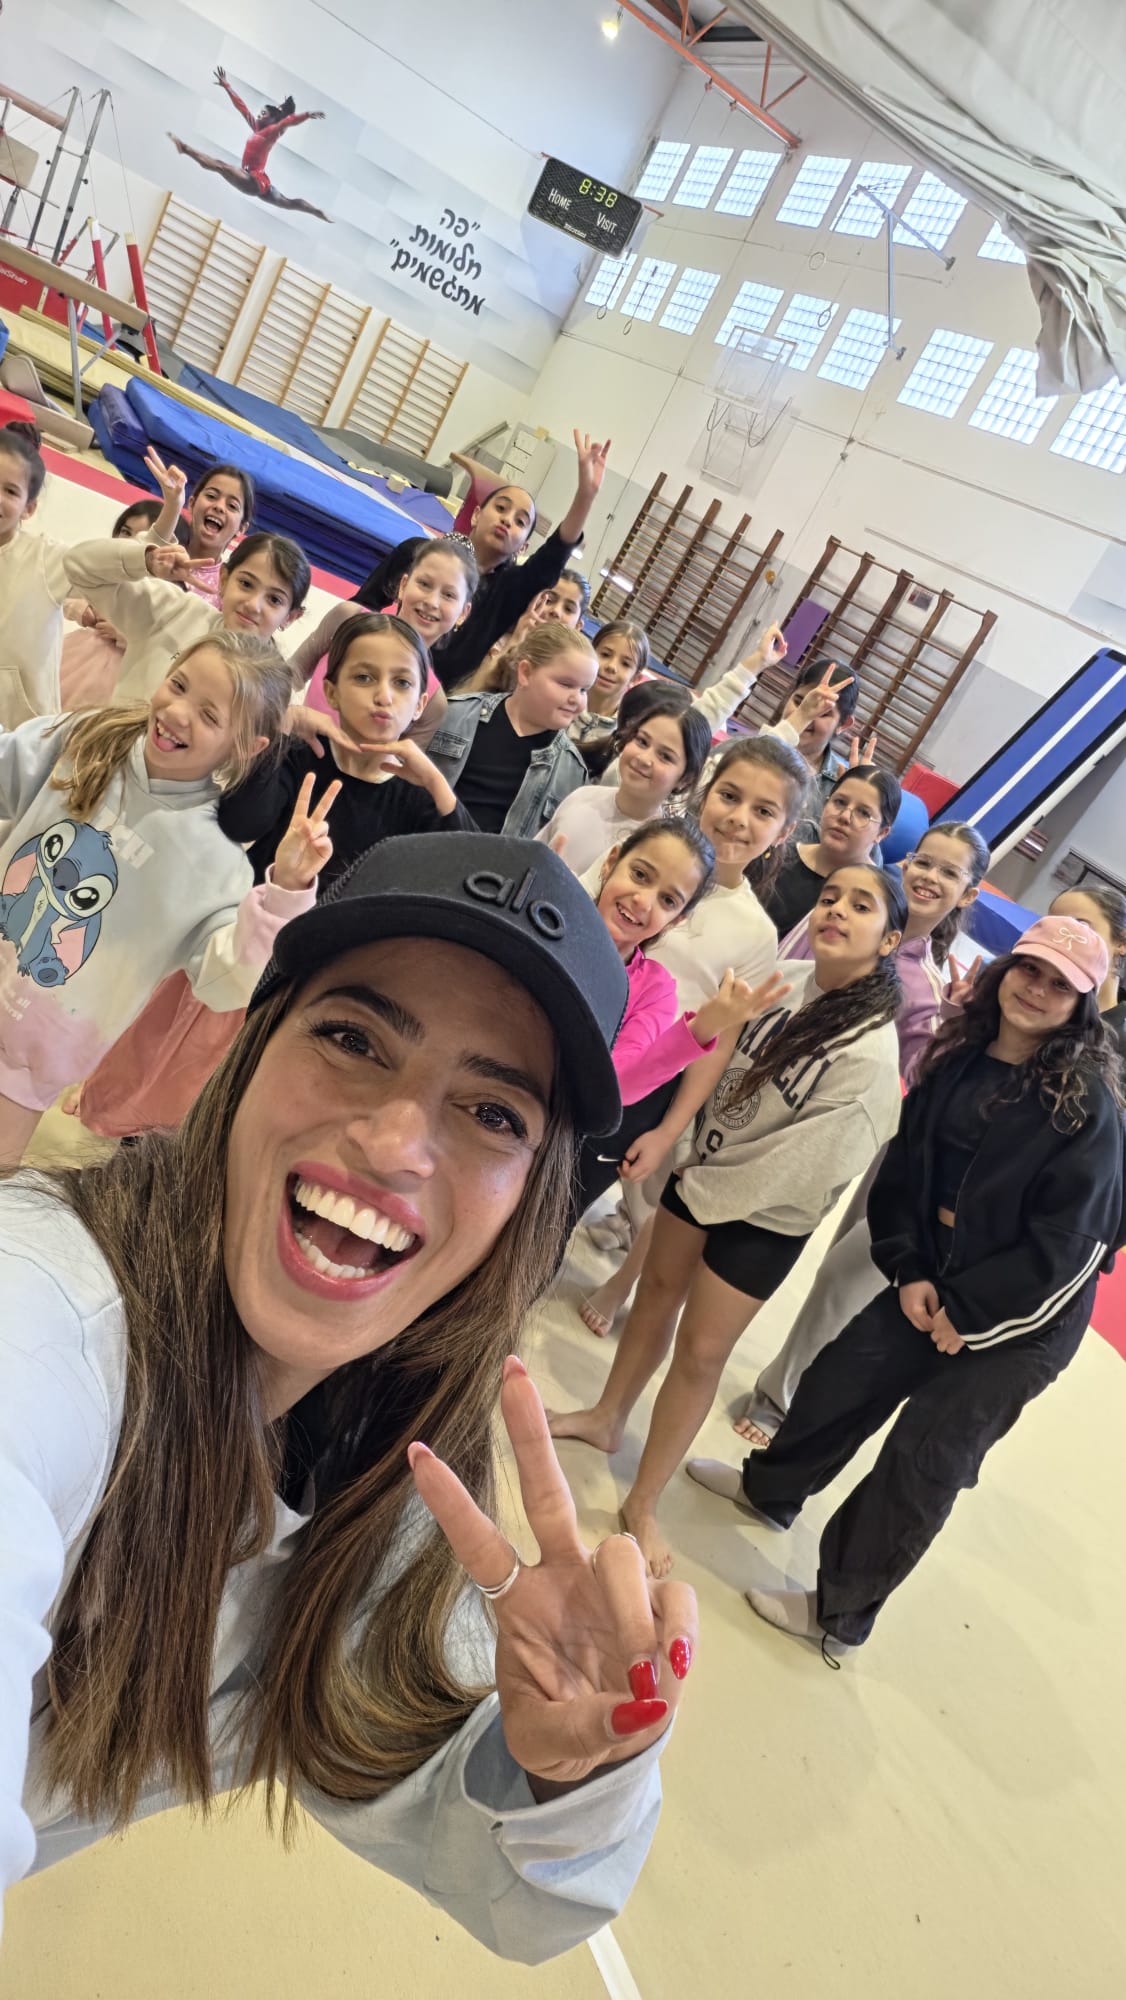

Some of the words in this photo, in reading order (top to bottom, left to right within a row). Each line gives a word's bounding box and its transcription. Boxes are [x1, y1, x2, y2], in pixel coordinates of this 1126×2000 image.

[548, 188, 572, 211] HOME
[579, 178, 617, 208] 8:38
[409, 224, 482, 280] חלומות
[463, 867, 565, 940] alo
